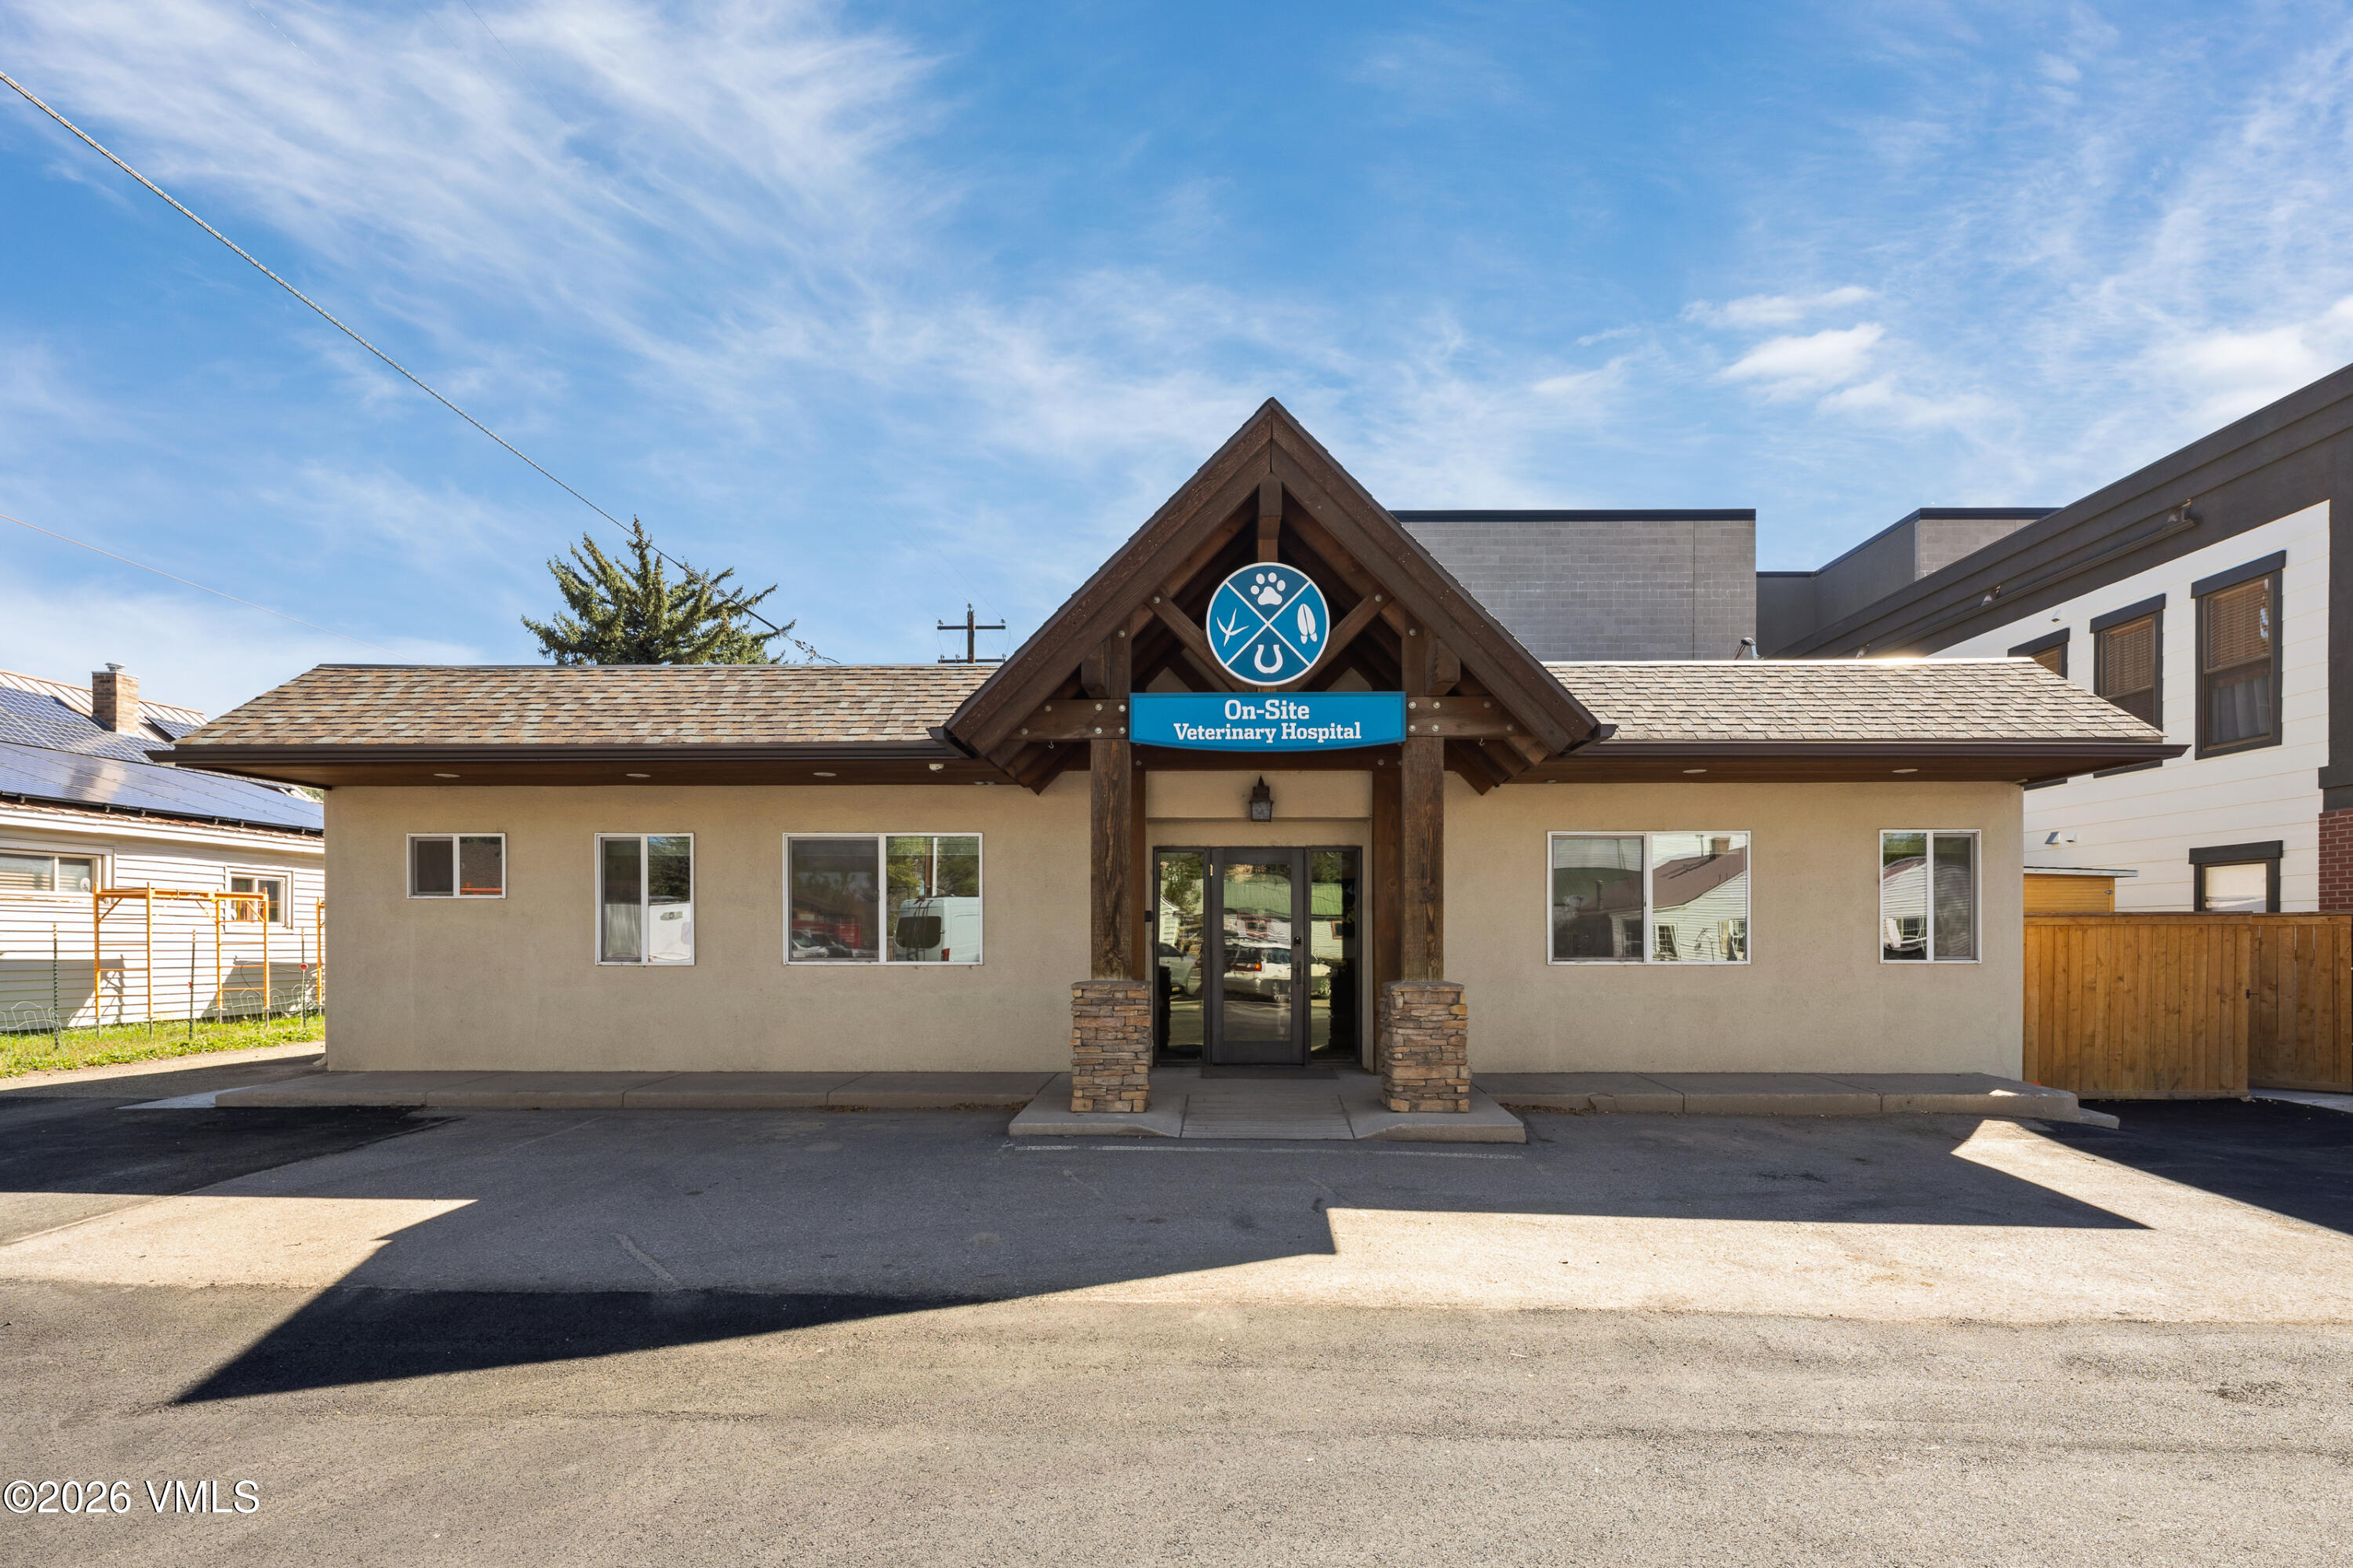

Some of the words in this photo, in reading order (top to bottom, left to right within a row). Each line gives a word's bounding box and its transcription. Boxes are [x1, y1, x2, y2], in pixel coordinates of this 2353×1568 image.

[1224, 699, 1310, 720] On-Site
[1173, 722, 1276, 744] Veterinary
[1281, 722, 1362, 744] Hospital
